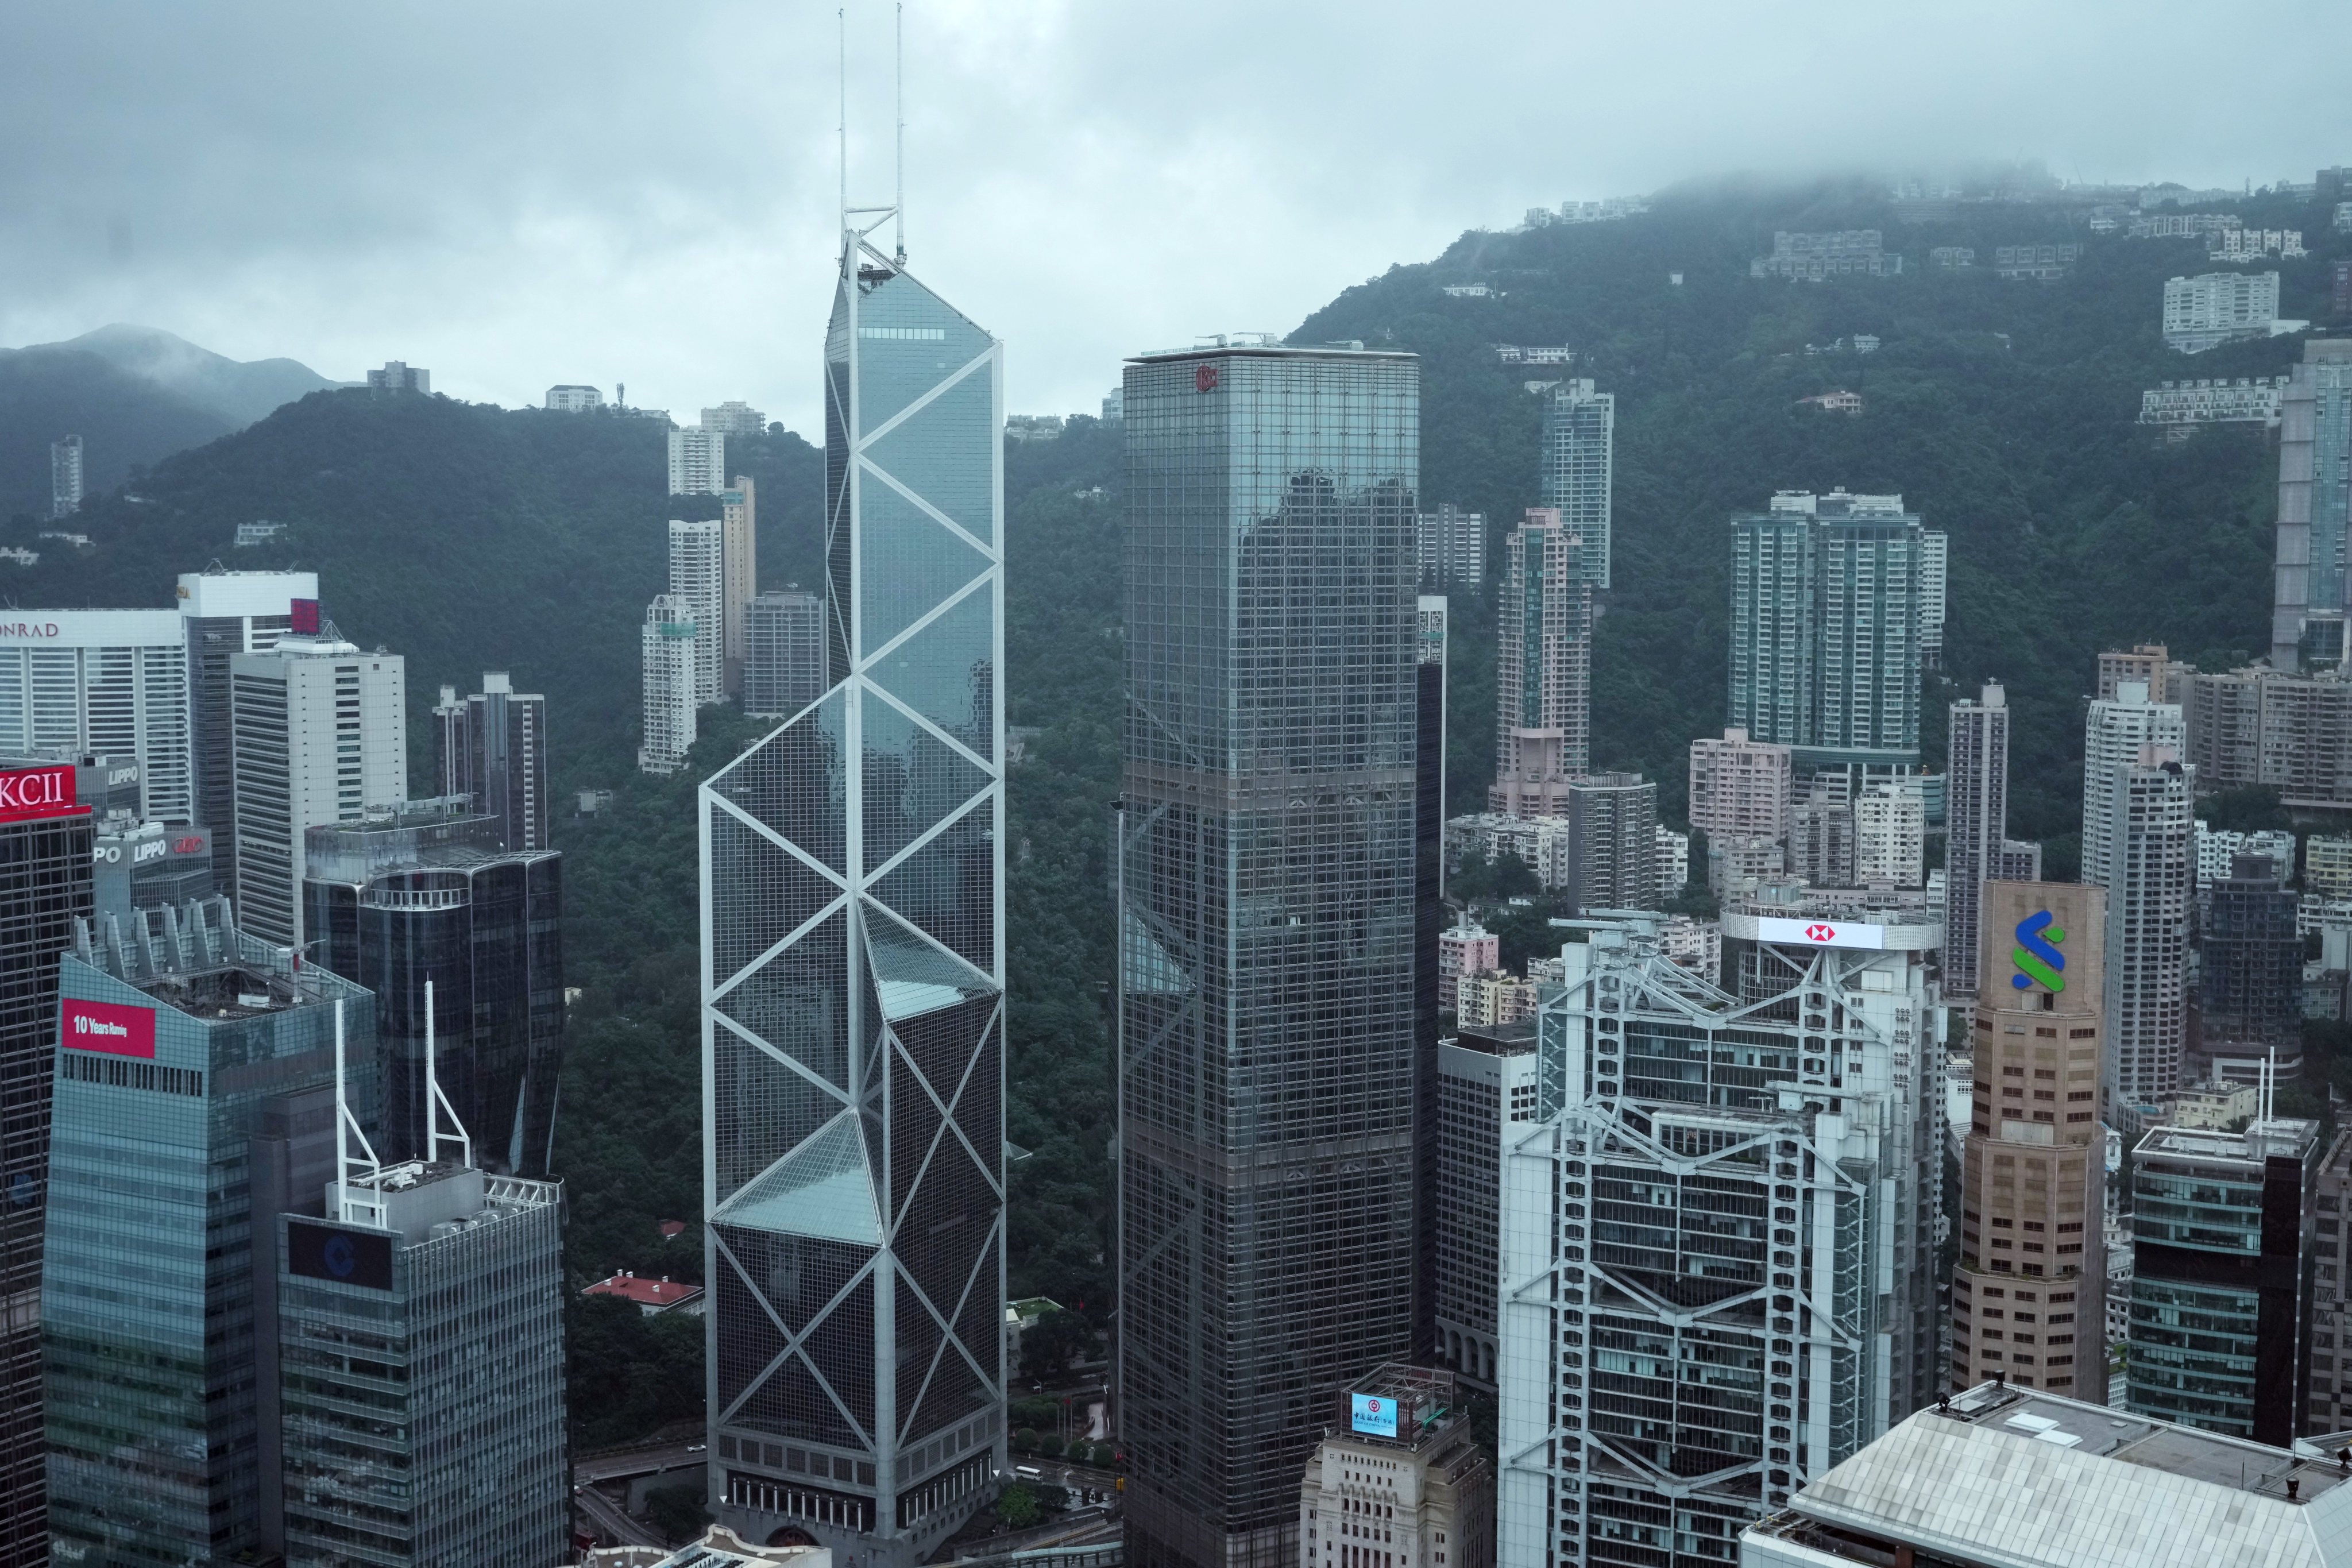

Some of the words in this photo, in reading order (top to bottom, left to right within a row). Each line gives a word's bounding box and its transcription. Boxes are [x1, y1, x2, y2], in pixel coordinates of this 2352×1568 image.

[0, 623, 59, 637] NRAD
[108, 766, 138, 786] LIPPO
[0, 773, 64, 808] KCII
[93, 847, 121, 863] PO
[134, 839, 166, 863] LIPPO
[74, 1015, 87, 1034] 10
[88, 1017, 109, 1034] Years
[109, 1022, 127, 1038] Running
